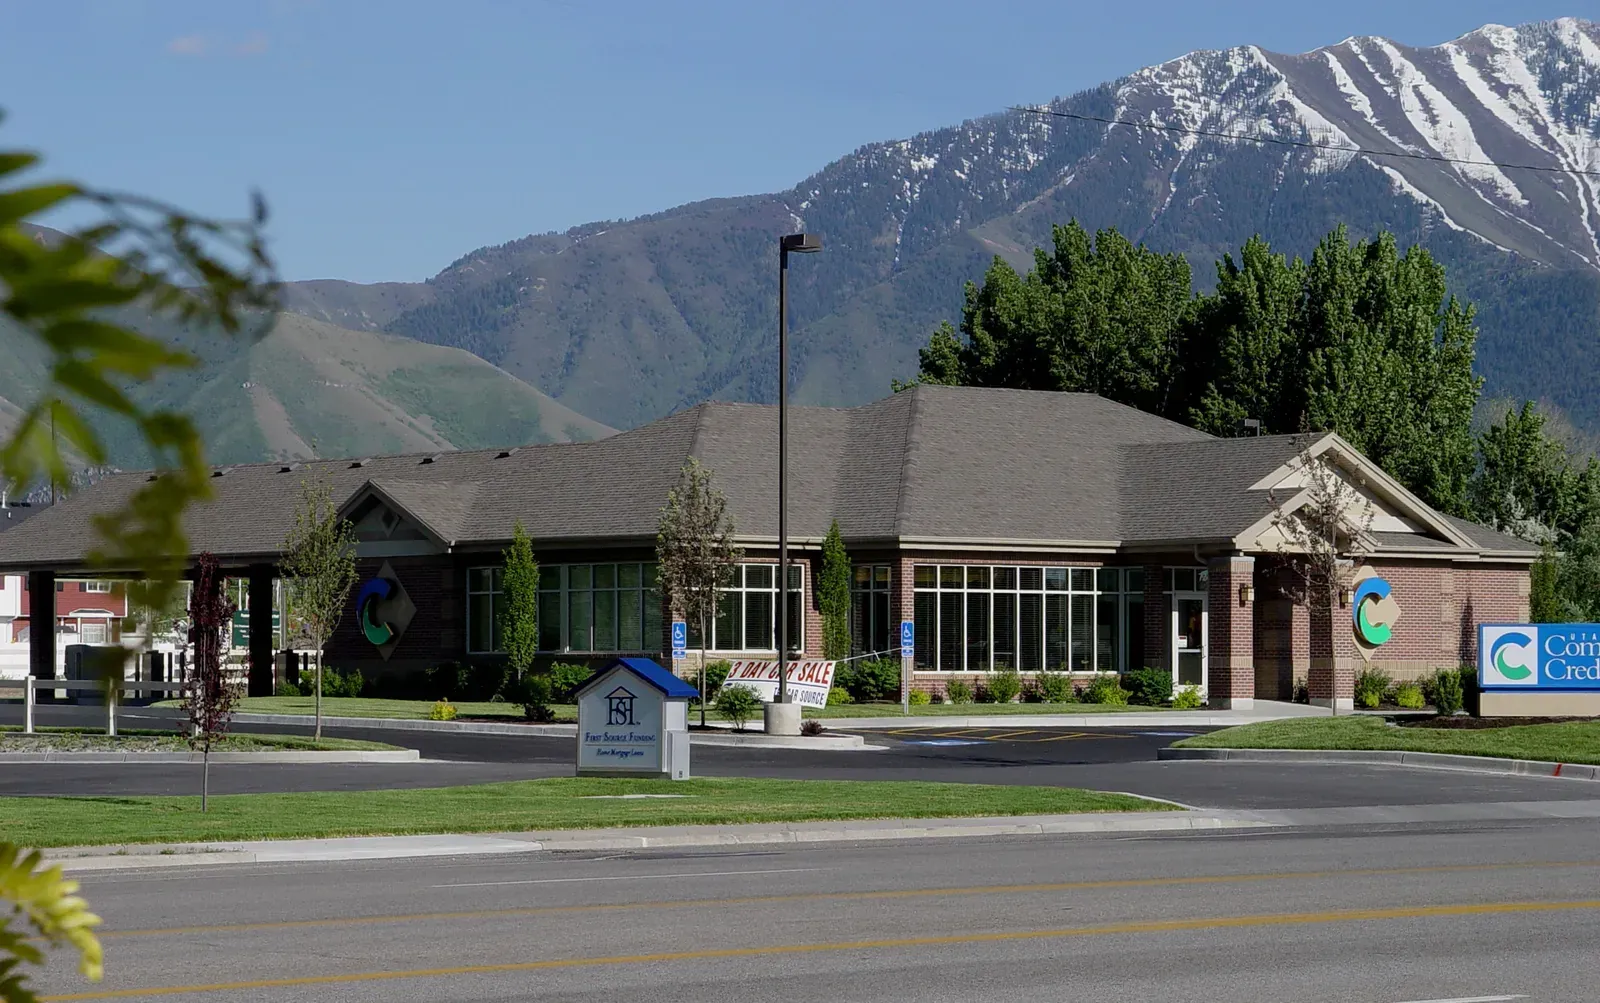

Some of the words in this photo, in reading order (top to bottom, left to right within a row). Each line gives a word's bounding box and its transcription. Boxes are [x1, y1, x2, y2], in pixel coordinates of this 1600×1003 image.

[1545, 635, 1600, 656] Com
[728, 661, 742, 678] 3
[740, 661, 771, 679] DAY
[797, 662, 832, 684] SALE
[1545, 658, 1600, 680] Cred
[800, 690, 825, 705] SOURCE
